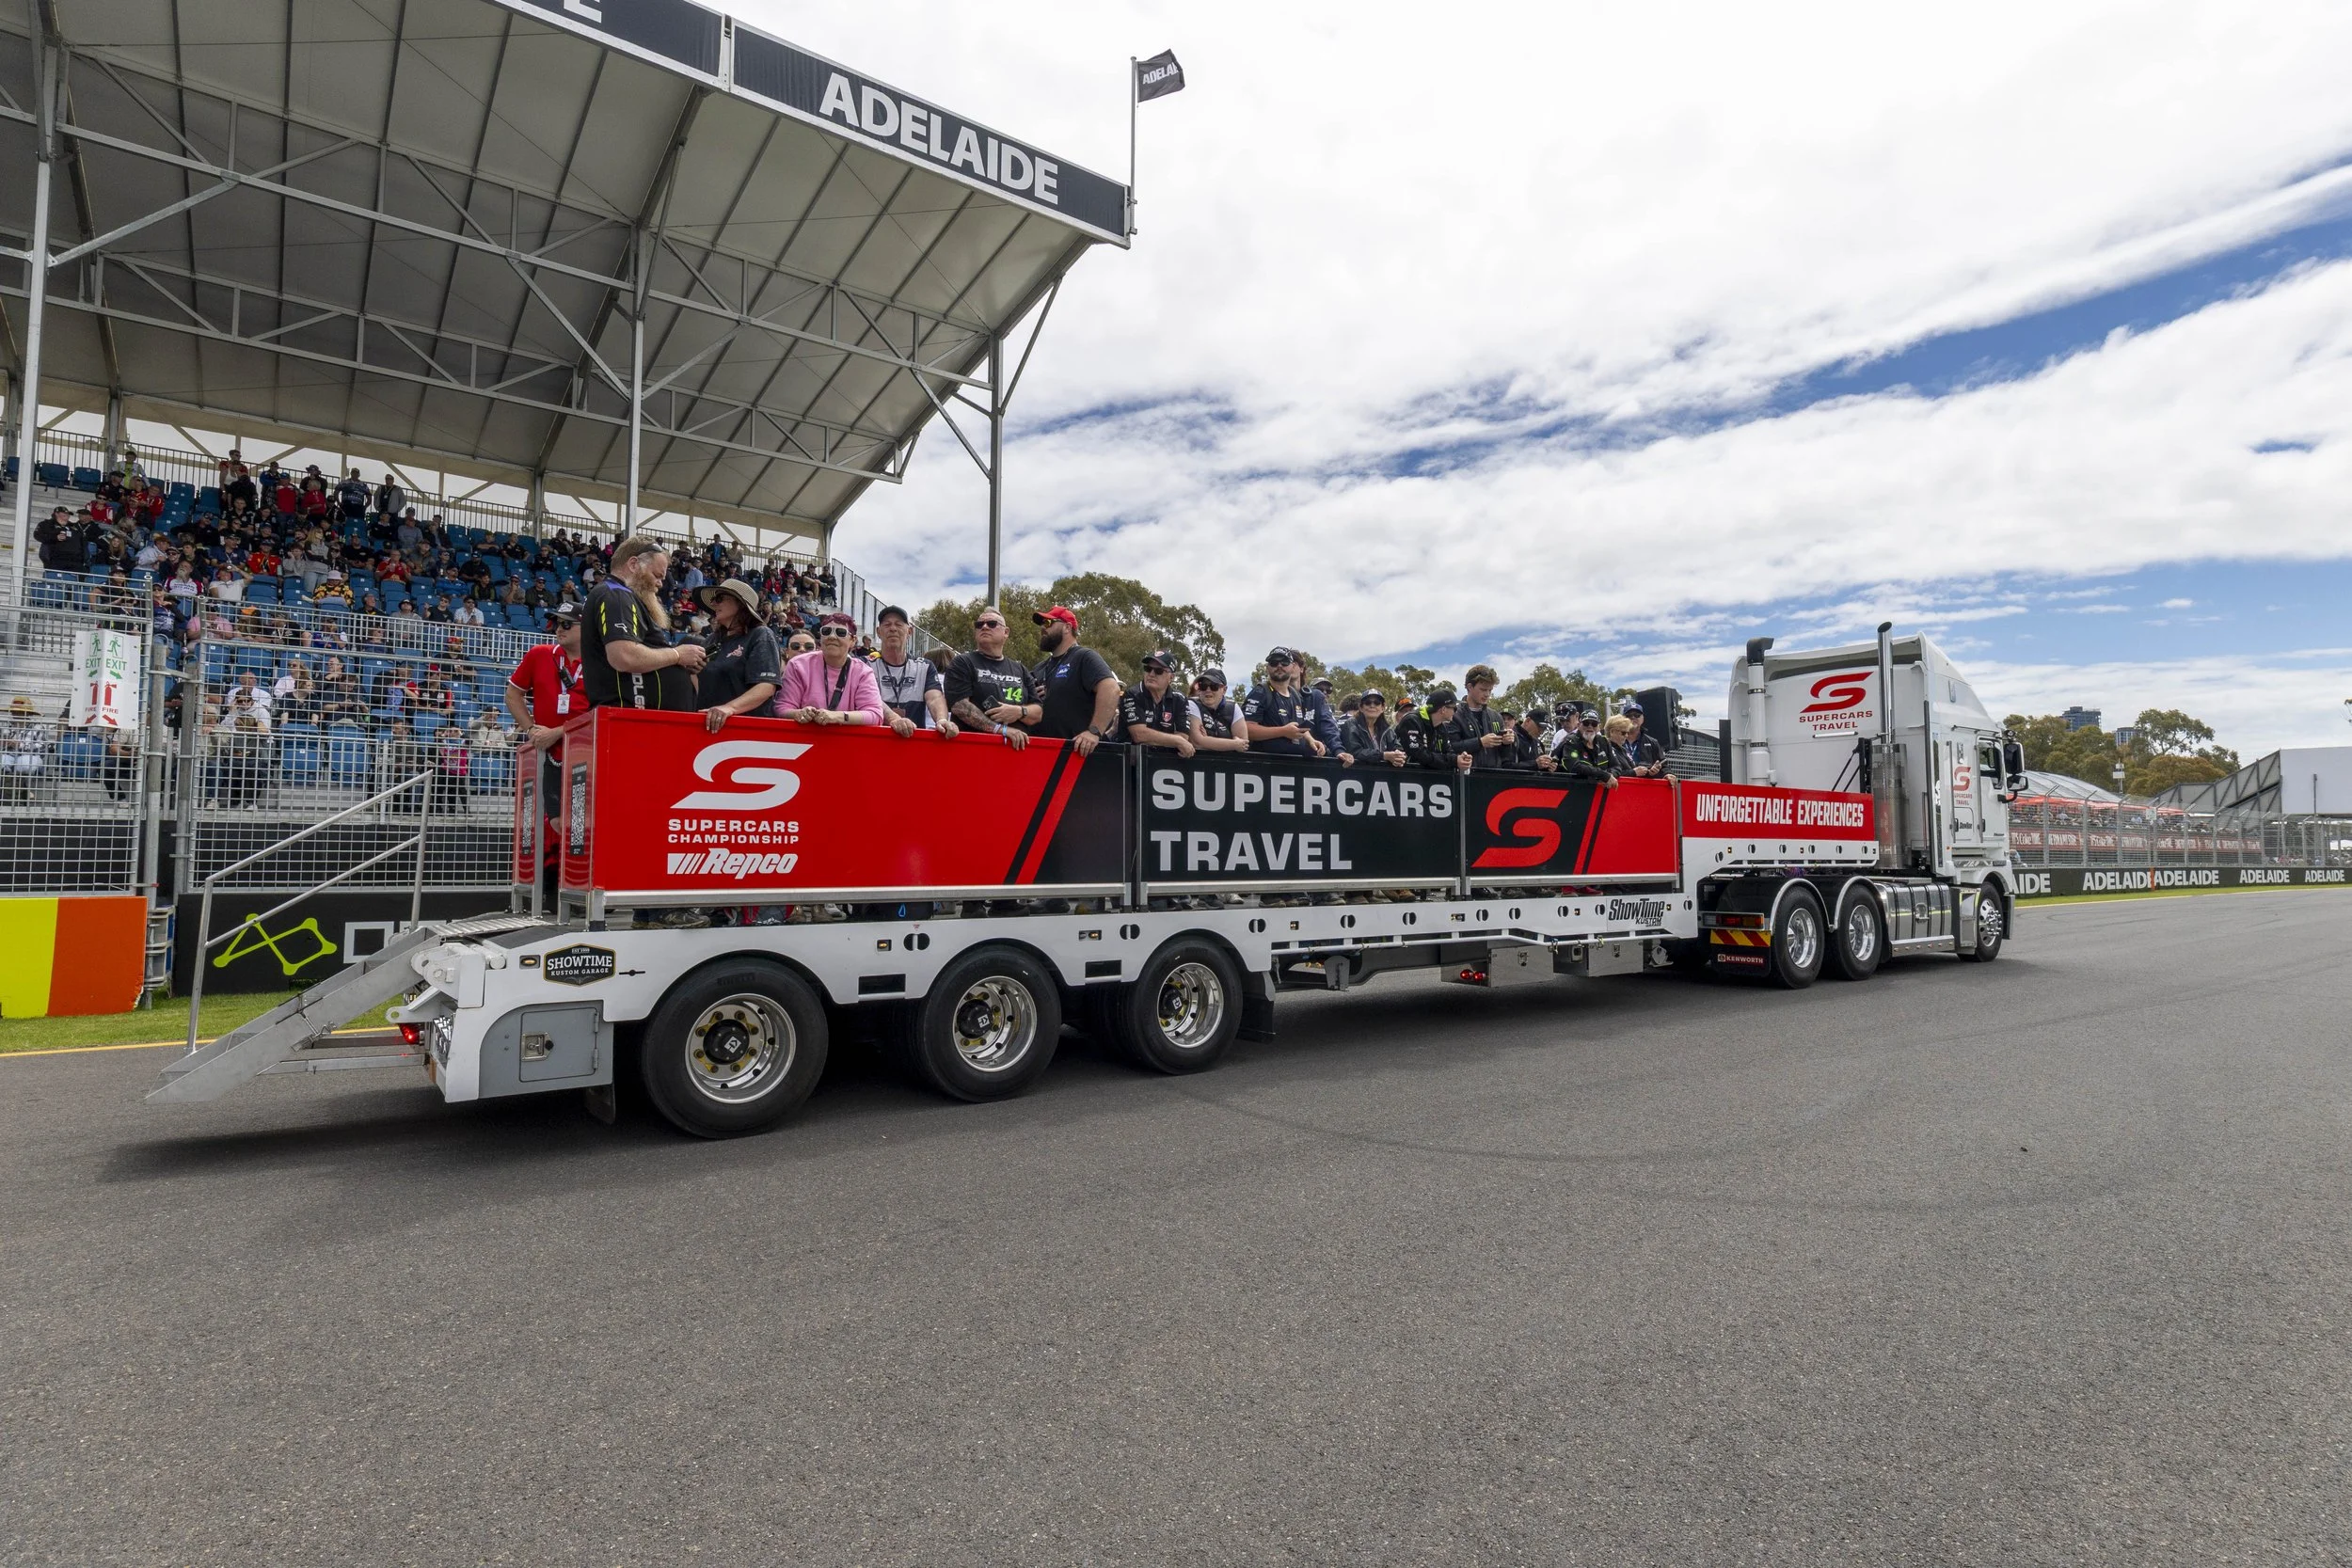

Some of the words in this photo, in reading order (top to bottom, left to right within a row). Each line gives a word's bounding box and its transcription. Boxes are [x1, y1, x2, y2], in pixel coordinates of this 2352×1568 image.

[1142, 62, 1179, 85] ADELAI
[818, 71, 1058, 205] ADELAIDE
[86, 657, 102, 669] EXIT
[105, 659, 127, 671] EXIT
[1004, 687, 1023, 703] 14
[1799, 710, 1873, 723] SUPERCARS
[1813, 721, 1858, 731] TRAVEL
[1152, 768, 1453, 818] SUPERCARS
[1696, 793, 1792, 825] UNFORGETTABLE
[1797, 800, 1864, 828] EXPERIENCES
[668, 818, 799, 833] SUPERCARS
[668, 833, 799, 844] CHAMPIONSHIP
[1150, 831, 1353, 872] TRAVEL
[698, 847, 799, 879] Repco
[2010, 873, 2051, 894] AIDE
[2154, 870, 2219, 886] ADELAIDE
[2239, 869, 2290, 883] ADELAIDE
[2305, 870, 2345, 882] ADELAIDE
[1608, 898, 1665, 921] ShowTime
[547, 955, 612, 970] SHOWTIME
[1726, 955, 1764, 964] KENWORTH
